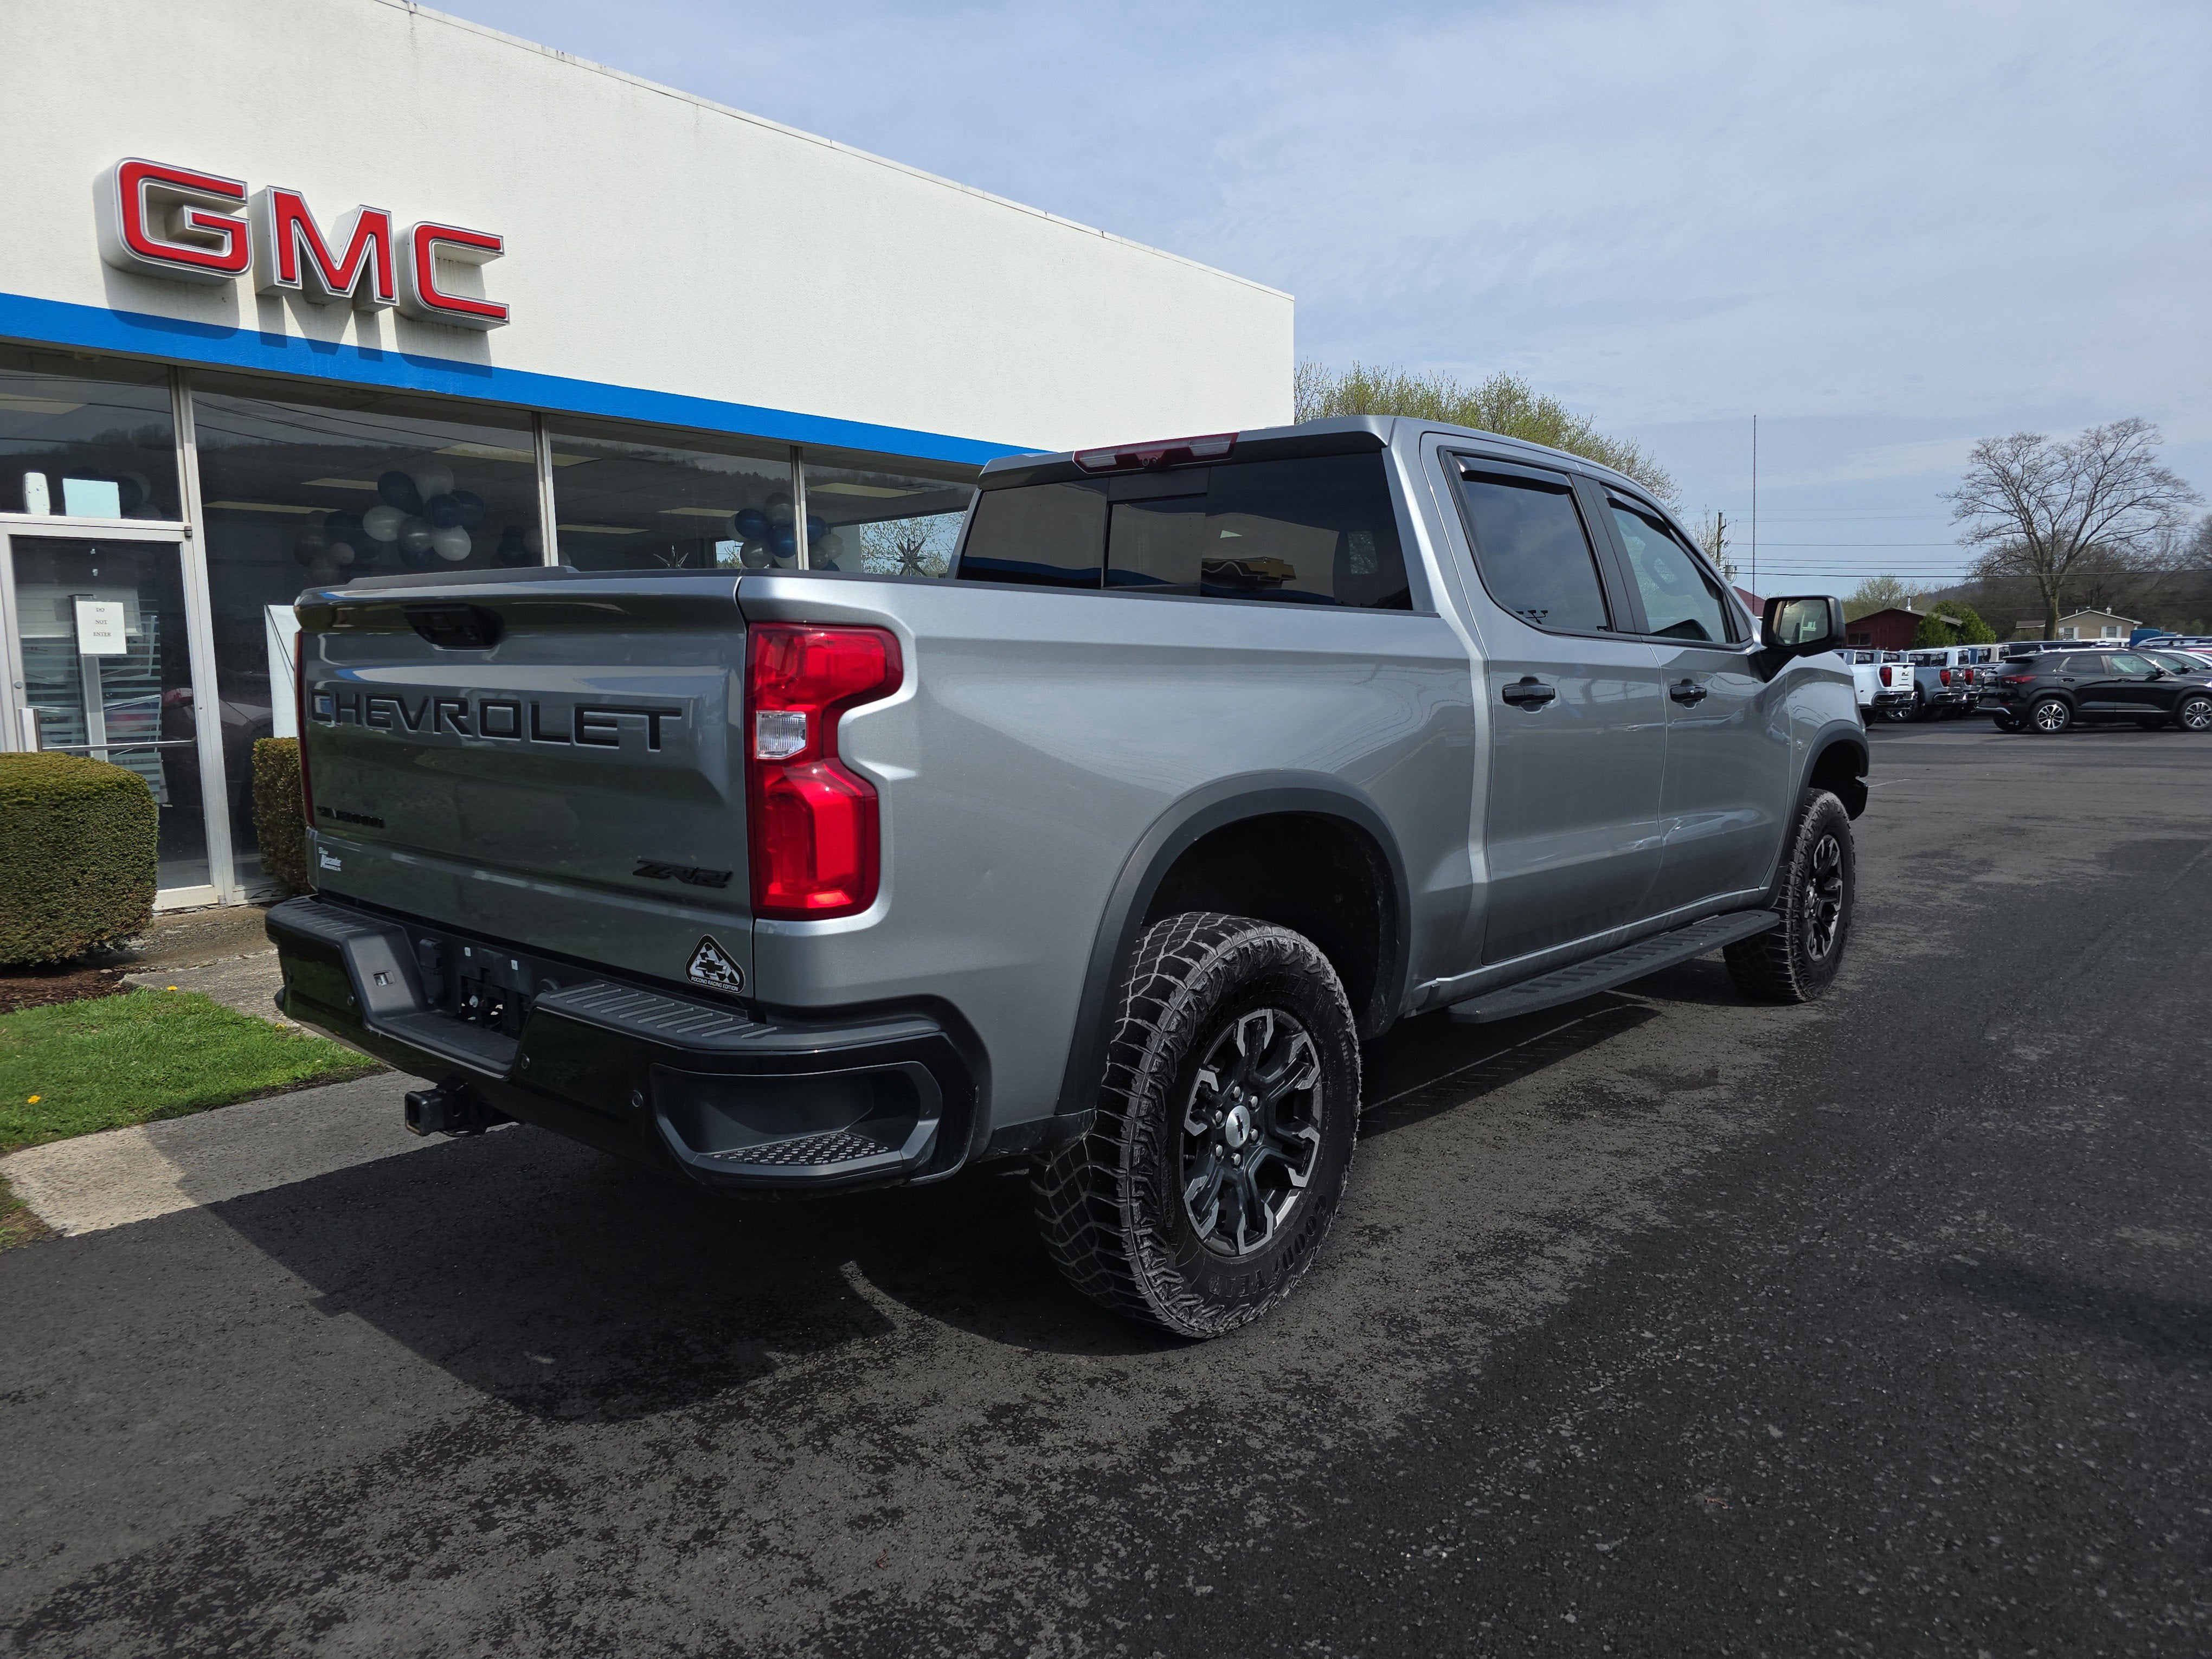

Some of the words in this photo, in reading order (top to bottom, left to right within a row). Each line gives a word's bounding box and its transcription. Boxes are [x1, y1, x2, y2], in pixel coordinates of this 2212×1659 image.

[106, 156, 511, 327] GMC
[310, 687, 683, 753] CHEVROLET
[632, 858, 734, 889] ZR2
